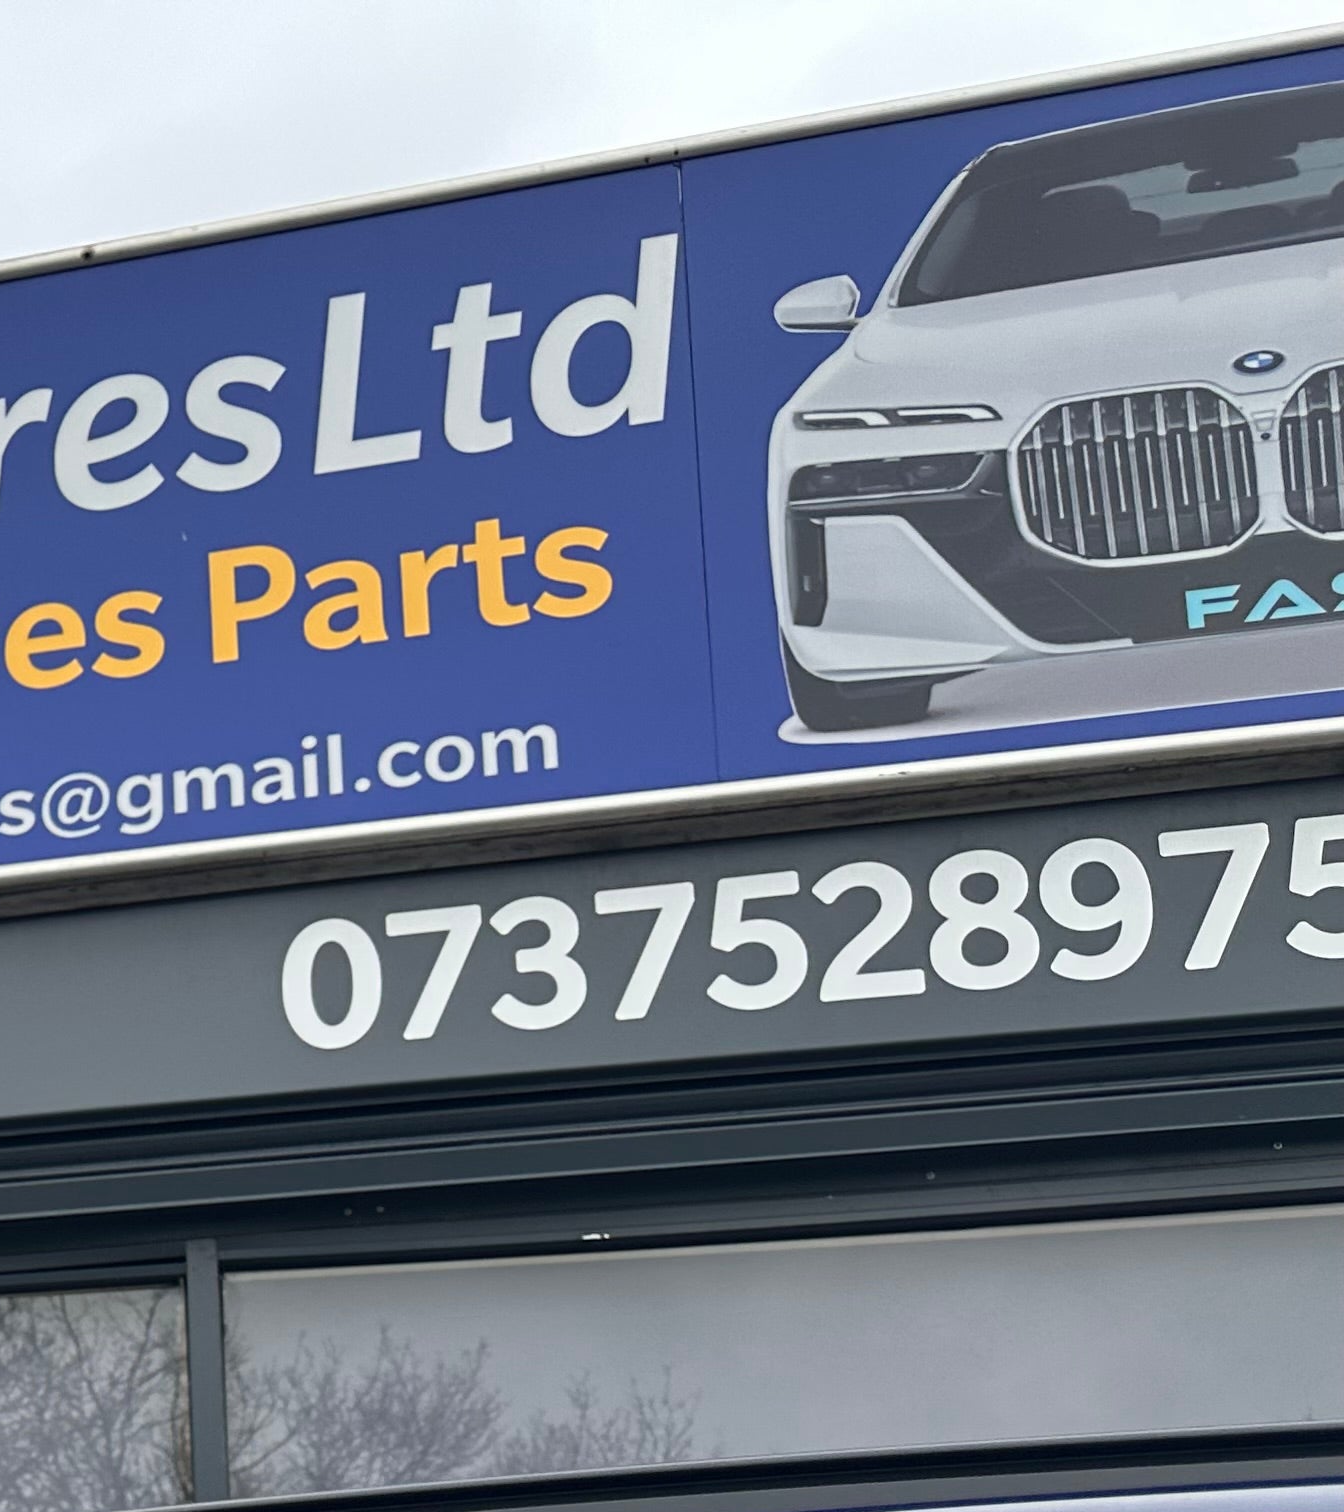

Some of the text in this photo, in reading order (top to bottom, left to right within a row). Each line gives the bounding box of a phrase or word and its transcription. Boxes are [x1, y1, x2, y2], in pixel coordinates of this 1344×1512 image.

[312, 233, 679, 476] Ltd
[207, 517, 613, 664] Parts
[1185, 570, 1344, 630] FA
[281, 813, 1344, 1050] 0737528975
